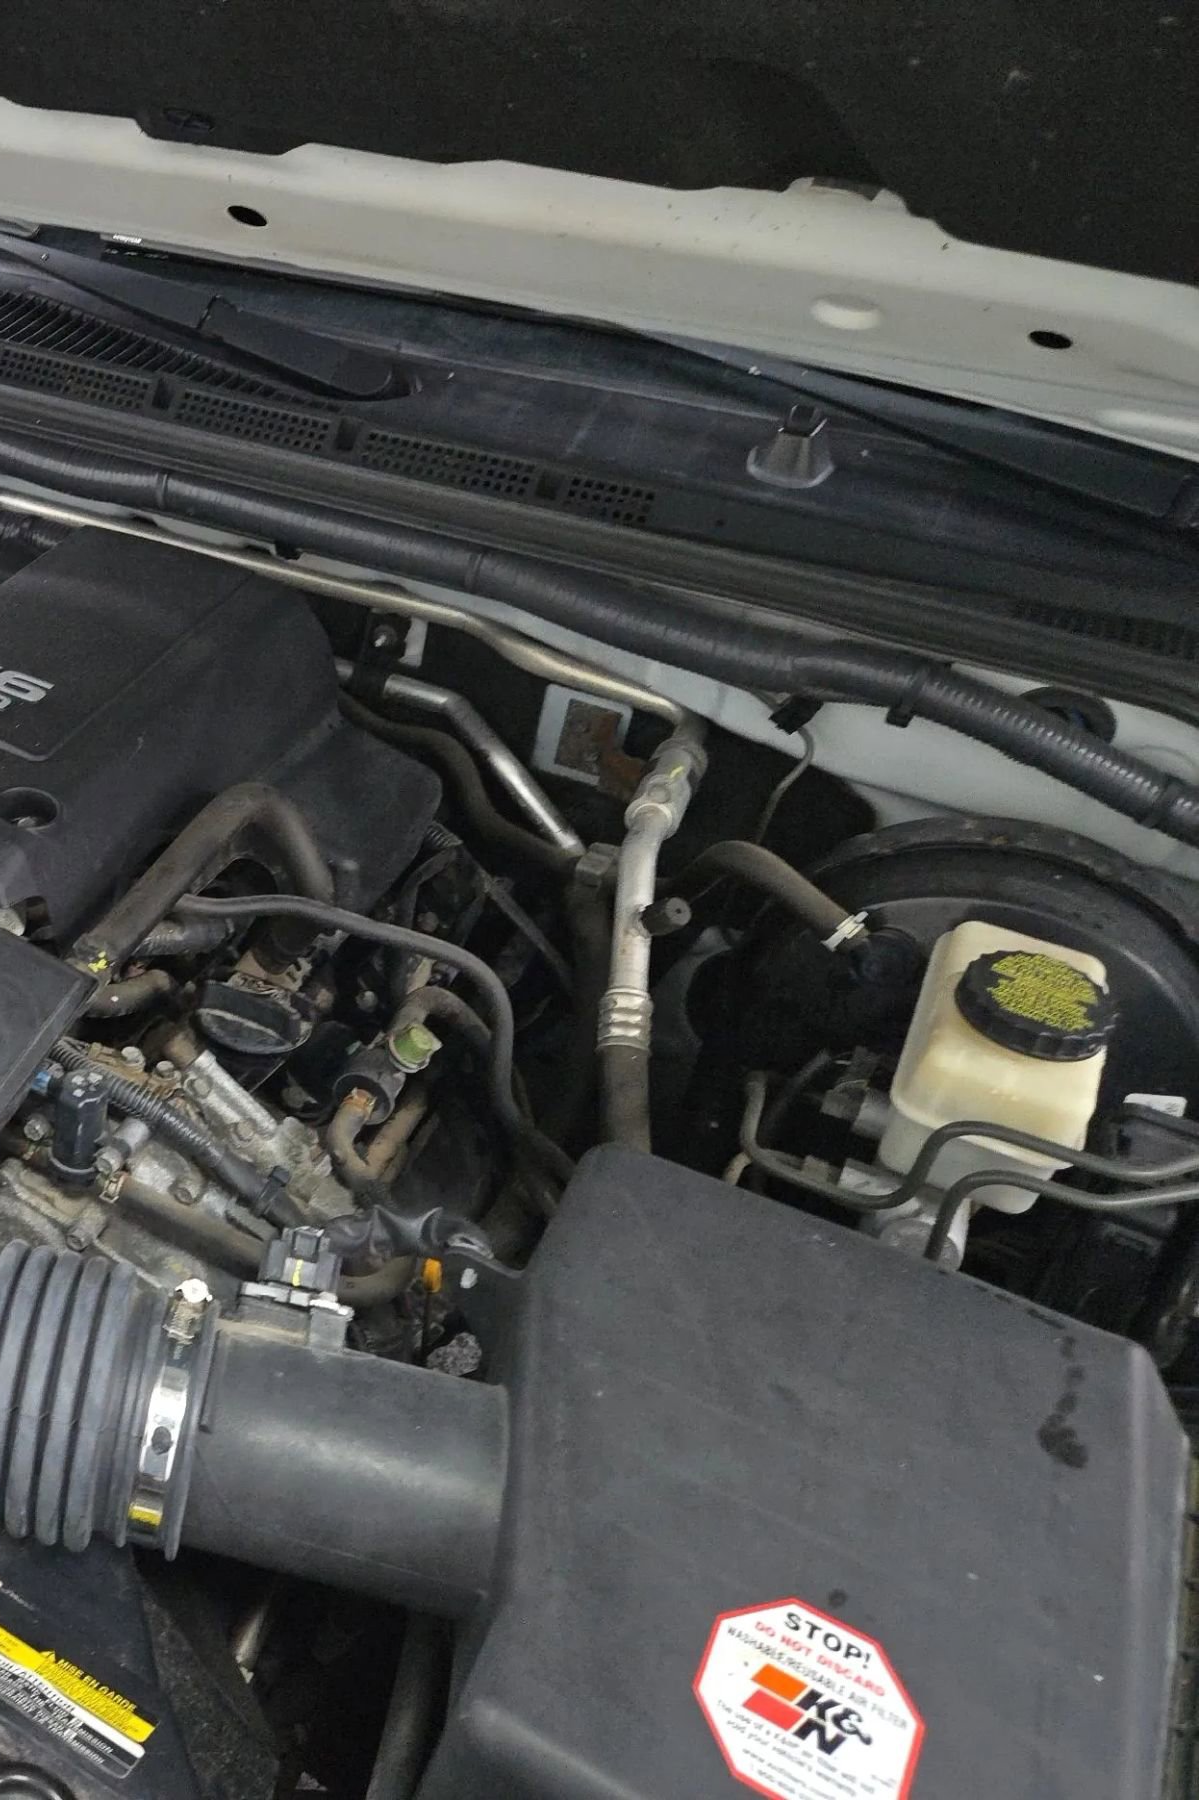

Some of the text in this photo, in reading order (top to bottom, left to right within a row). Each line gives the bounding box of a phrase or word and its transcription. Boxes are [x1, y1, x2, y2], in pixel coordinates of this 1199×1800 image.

[755, 1621, 886, 1697] DO NOT DISCARD
[784, 1612, 871, 1669] STOP!
[57, 1658, 137, 1713] MISE EN GARDE
[848, 1691, 867, 1709] AIR
[871, 1703, 907, 1730] FILTER
